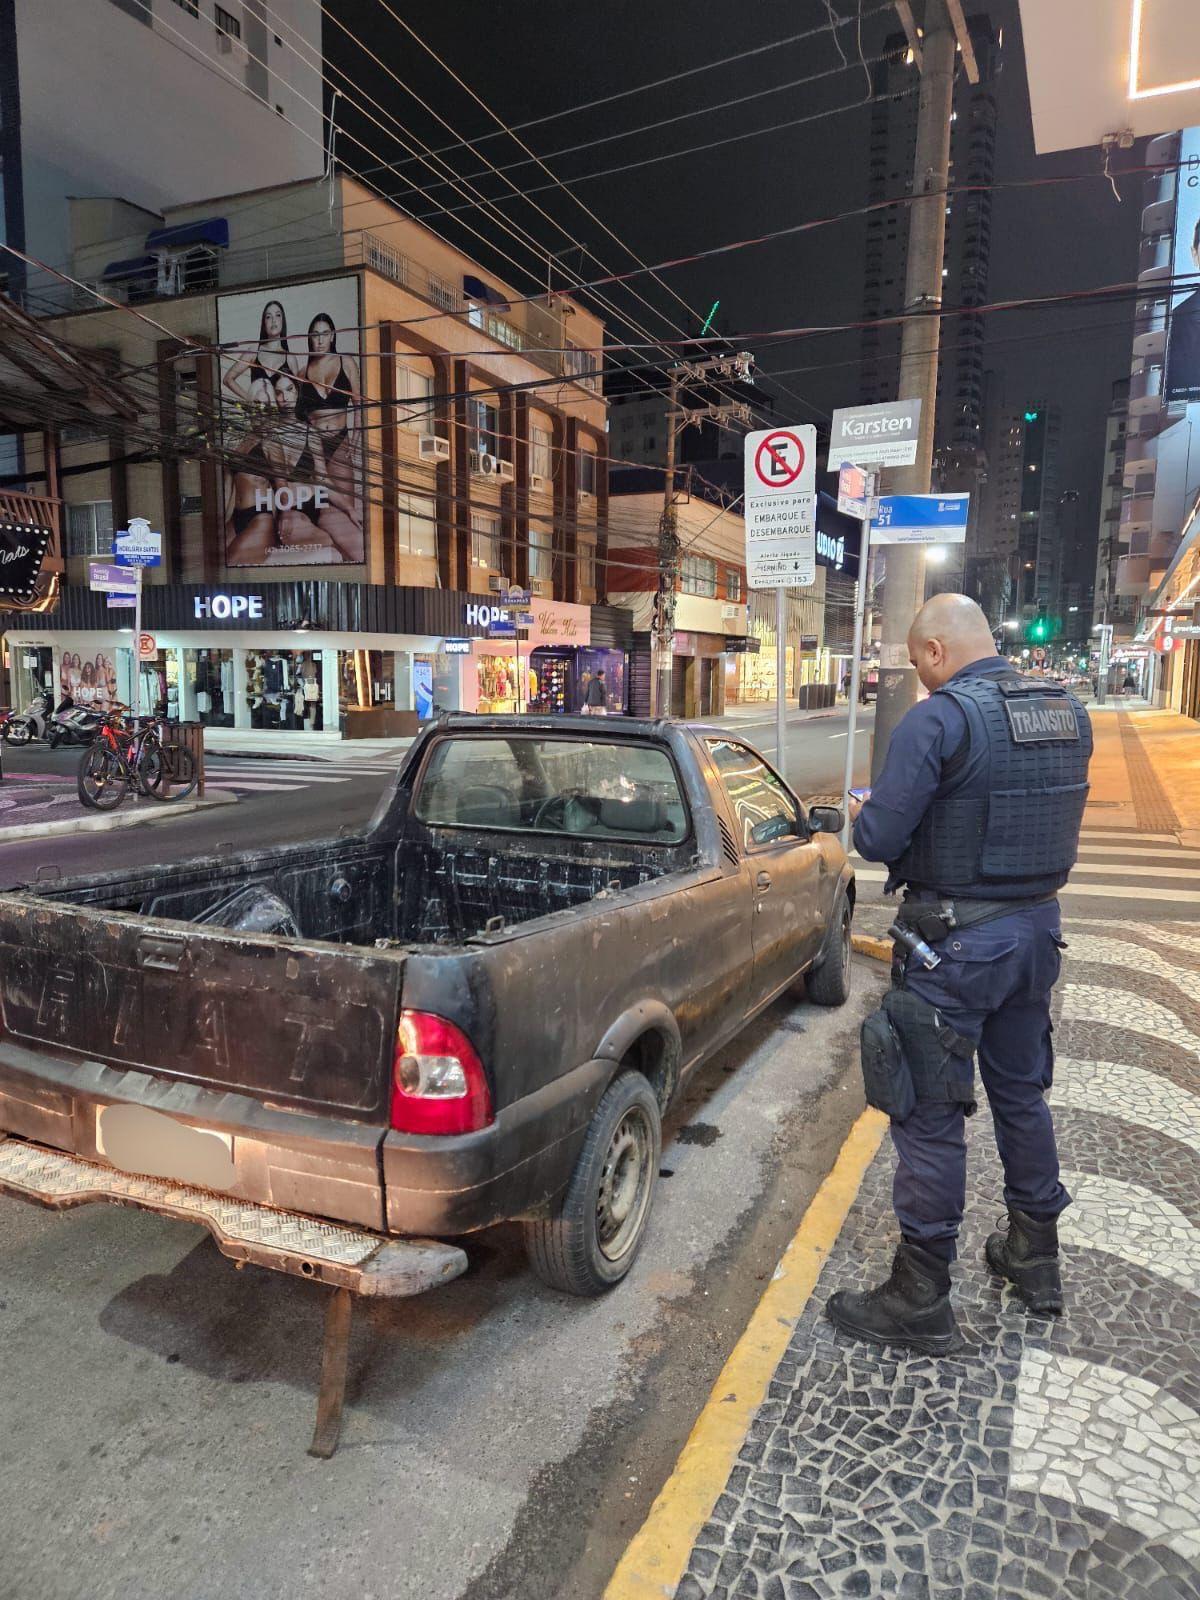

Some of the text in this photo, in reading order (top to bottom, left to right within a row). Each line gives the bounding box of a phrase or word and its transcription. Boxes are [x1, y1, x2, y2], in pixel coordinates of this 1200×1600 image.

[841, 416, 912, 437] Karsten
[255, 485, 330, 512] HOPE
[879, 504, 893, 514] Rua
[754, 510, 807, 523] EMBARQUE E
[878, 514, 891, 526] 51
[750, 524, 811, 538] DESEMBARQUE
[193, 594, 263, 619] HOPE
[466, 603, 509, 628] HOPE
[445, 642, 470, 653] HOPE
[74, 686, 103, 699] HOPE
